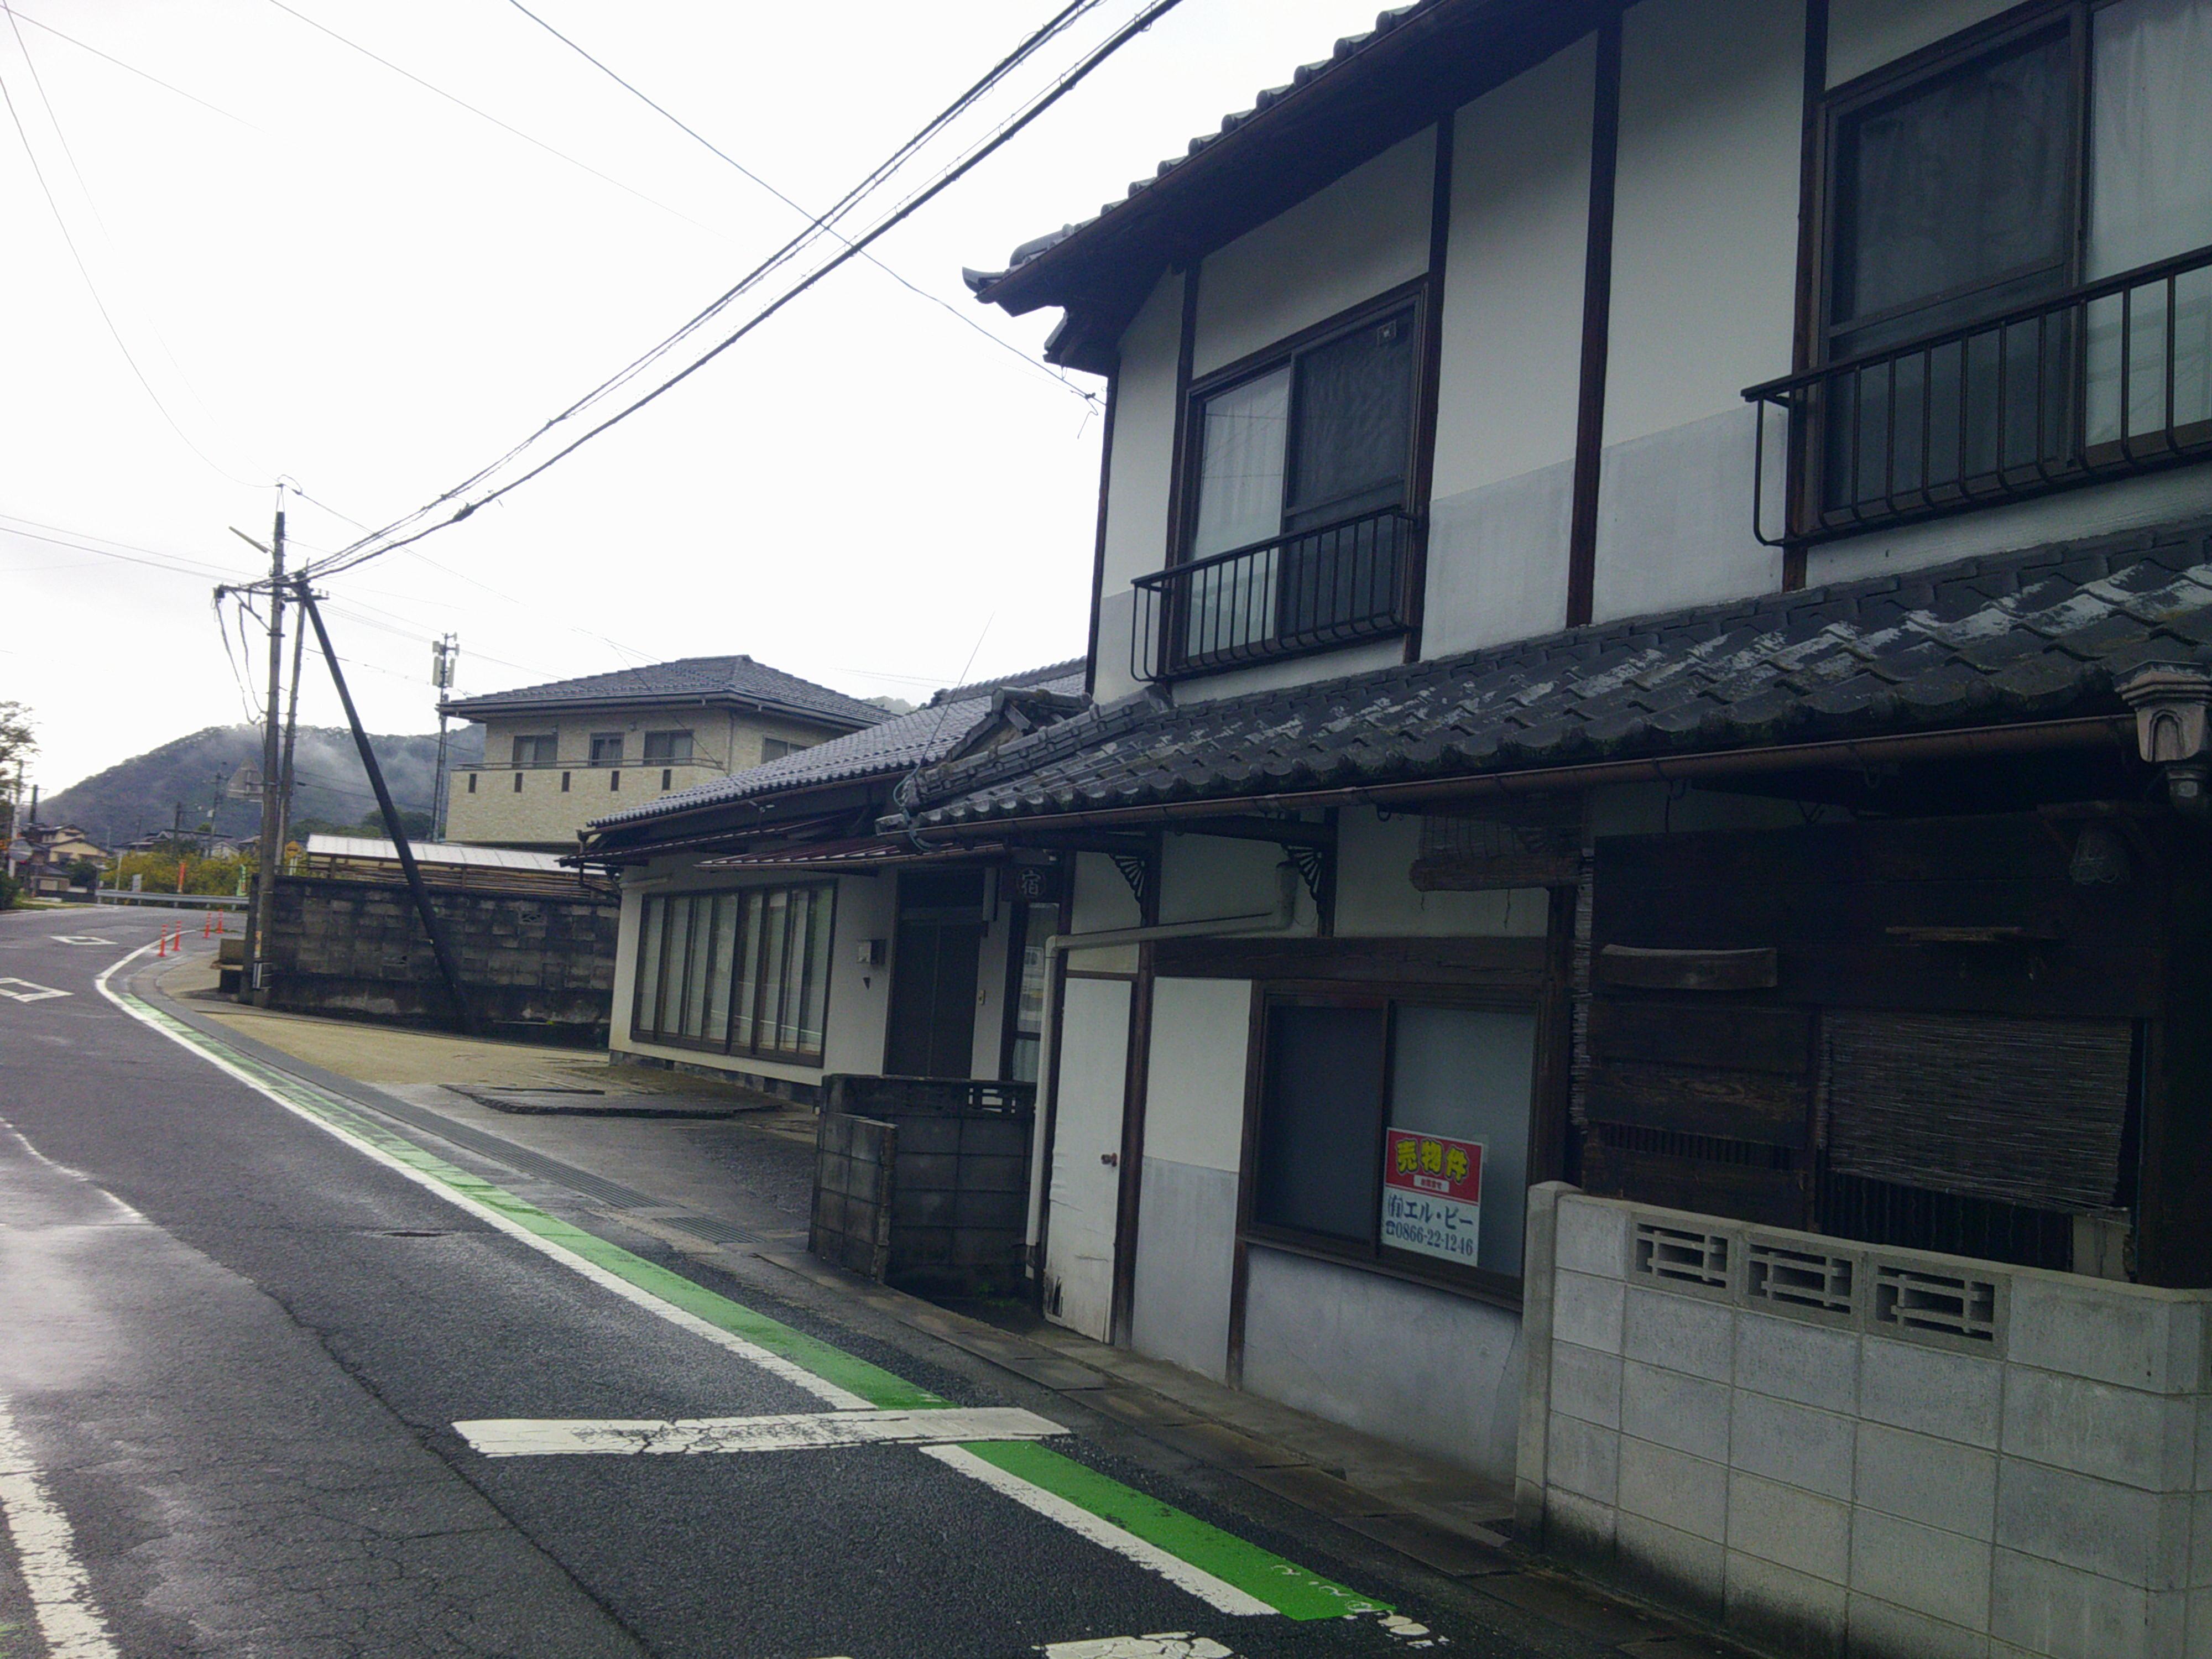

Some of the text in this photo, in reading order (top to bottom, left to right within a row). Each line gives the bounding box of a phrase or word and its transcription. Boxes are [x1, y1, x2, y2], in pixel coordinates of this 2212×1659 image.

[1021, 870, 1041, 894] 宿
[1396, 1138, 1469, 1184] 売物件
